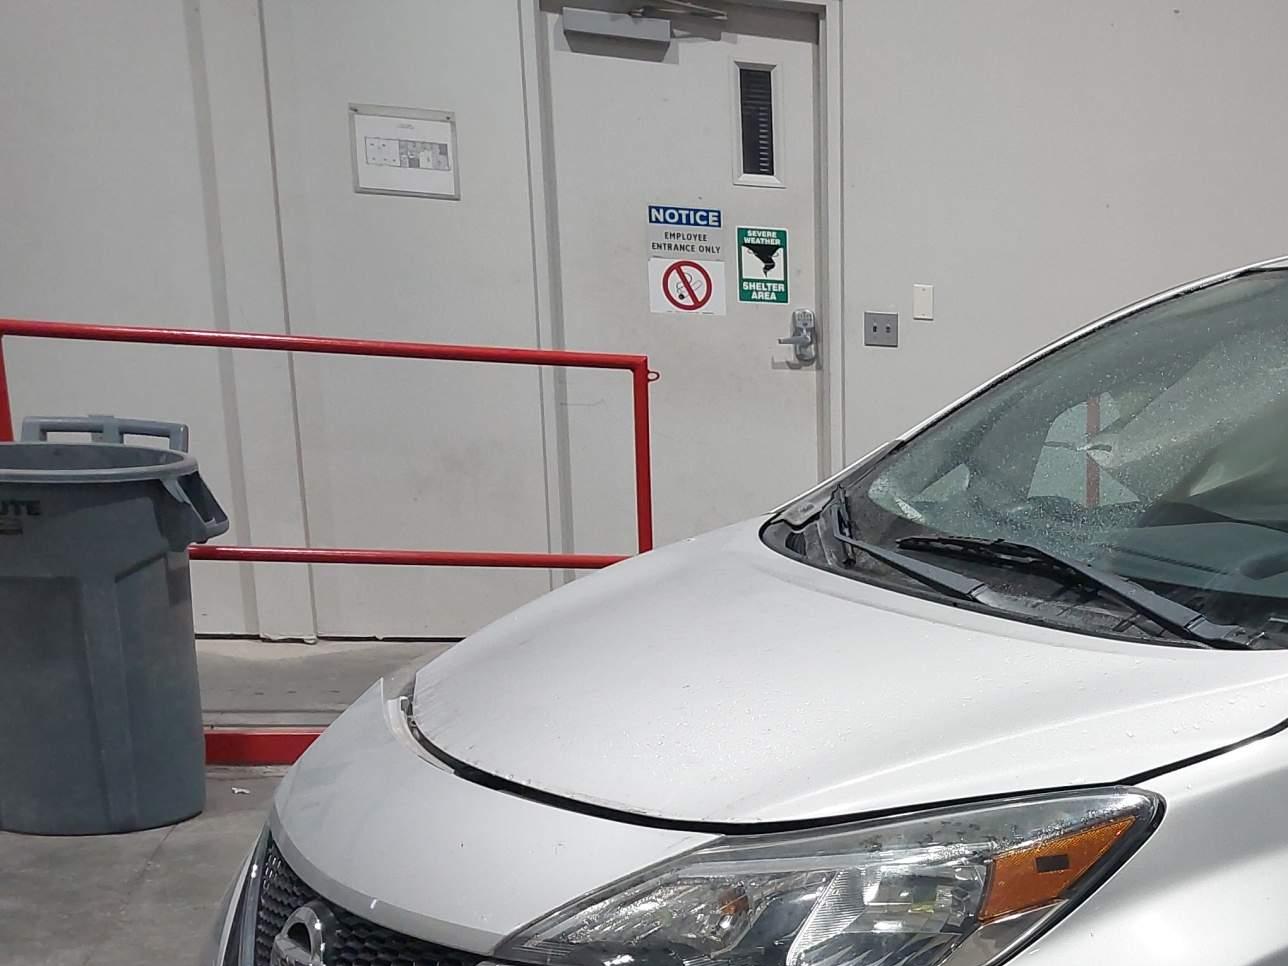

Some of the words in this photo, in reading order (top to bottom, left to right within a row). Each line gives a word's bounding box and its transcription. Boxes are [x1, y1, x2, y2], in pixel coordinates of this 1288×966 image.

[650, 207, 720, 226] NOTICE
[664, 231, 708, 242] EMPLOYEE
[746, 230, 777, 238] SEVERE
[743, 236, 781, 246] WEATHER
[651, 242, 696, 253] ENTRANCE
[698, 244, 721, 254] ONLY
[742, 282, 785, 292] SHELTER
[751, 291, 777, 301] AREA
